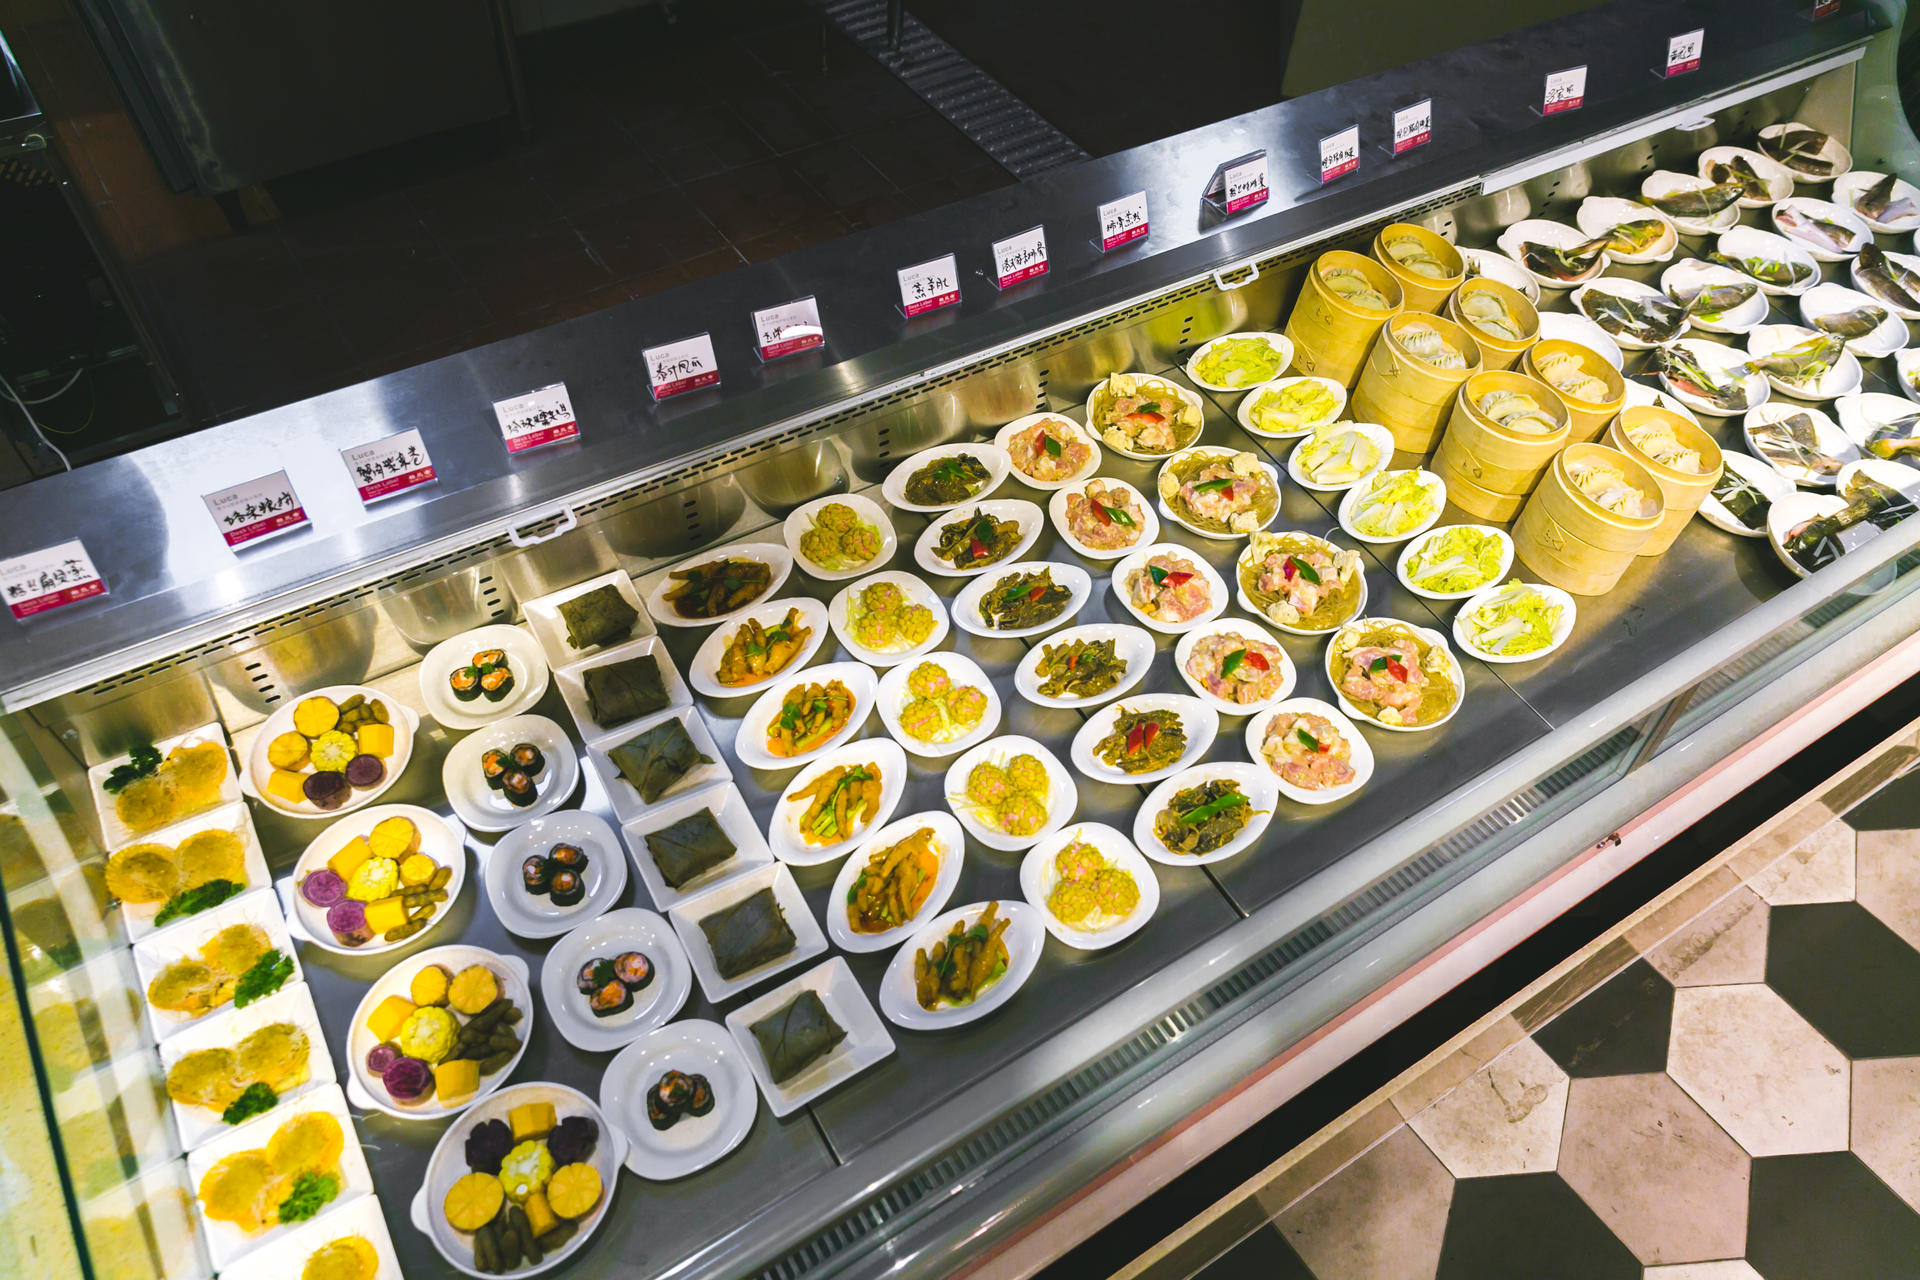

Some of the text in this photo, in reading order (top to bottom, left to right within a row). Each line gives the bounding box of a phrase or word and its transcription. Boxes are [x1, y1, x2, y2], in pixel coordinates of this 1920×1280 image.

[1103, 208, 1117, 217] Luca
[997, 245, 1012, 254] Luca
[903, 273, 919, 282] Luca
[920, 299, 934, 307] Label
[760, 314, 779, 322] Luca
[650, 352, 670, 361] Luca
[502, 404, 524, 413] Luca
[512, 436, 528, 444] Desk
[529, 431, 545, 439] Label
[351, 450, 375, 461] Luca
[365, 483, 382, 492] Desk
[382, 478, 399, 487] Label
[212, 494, 238, 506] Luca
[230, 528, 247, 538] Desk
[247, 521, 267, 532] Label
